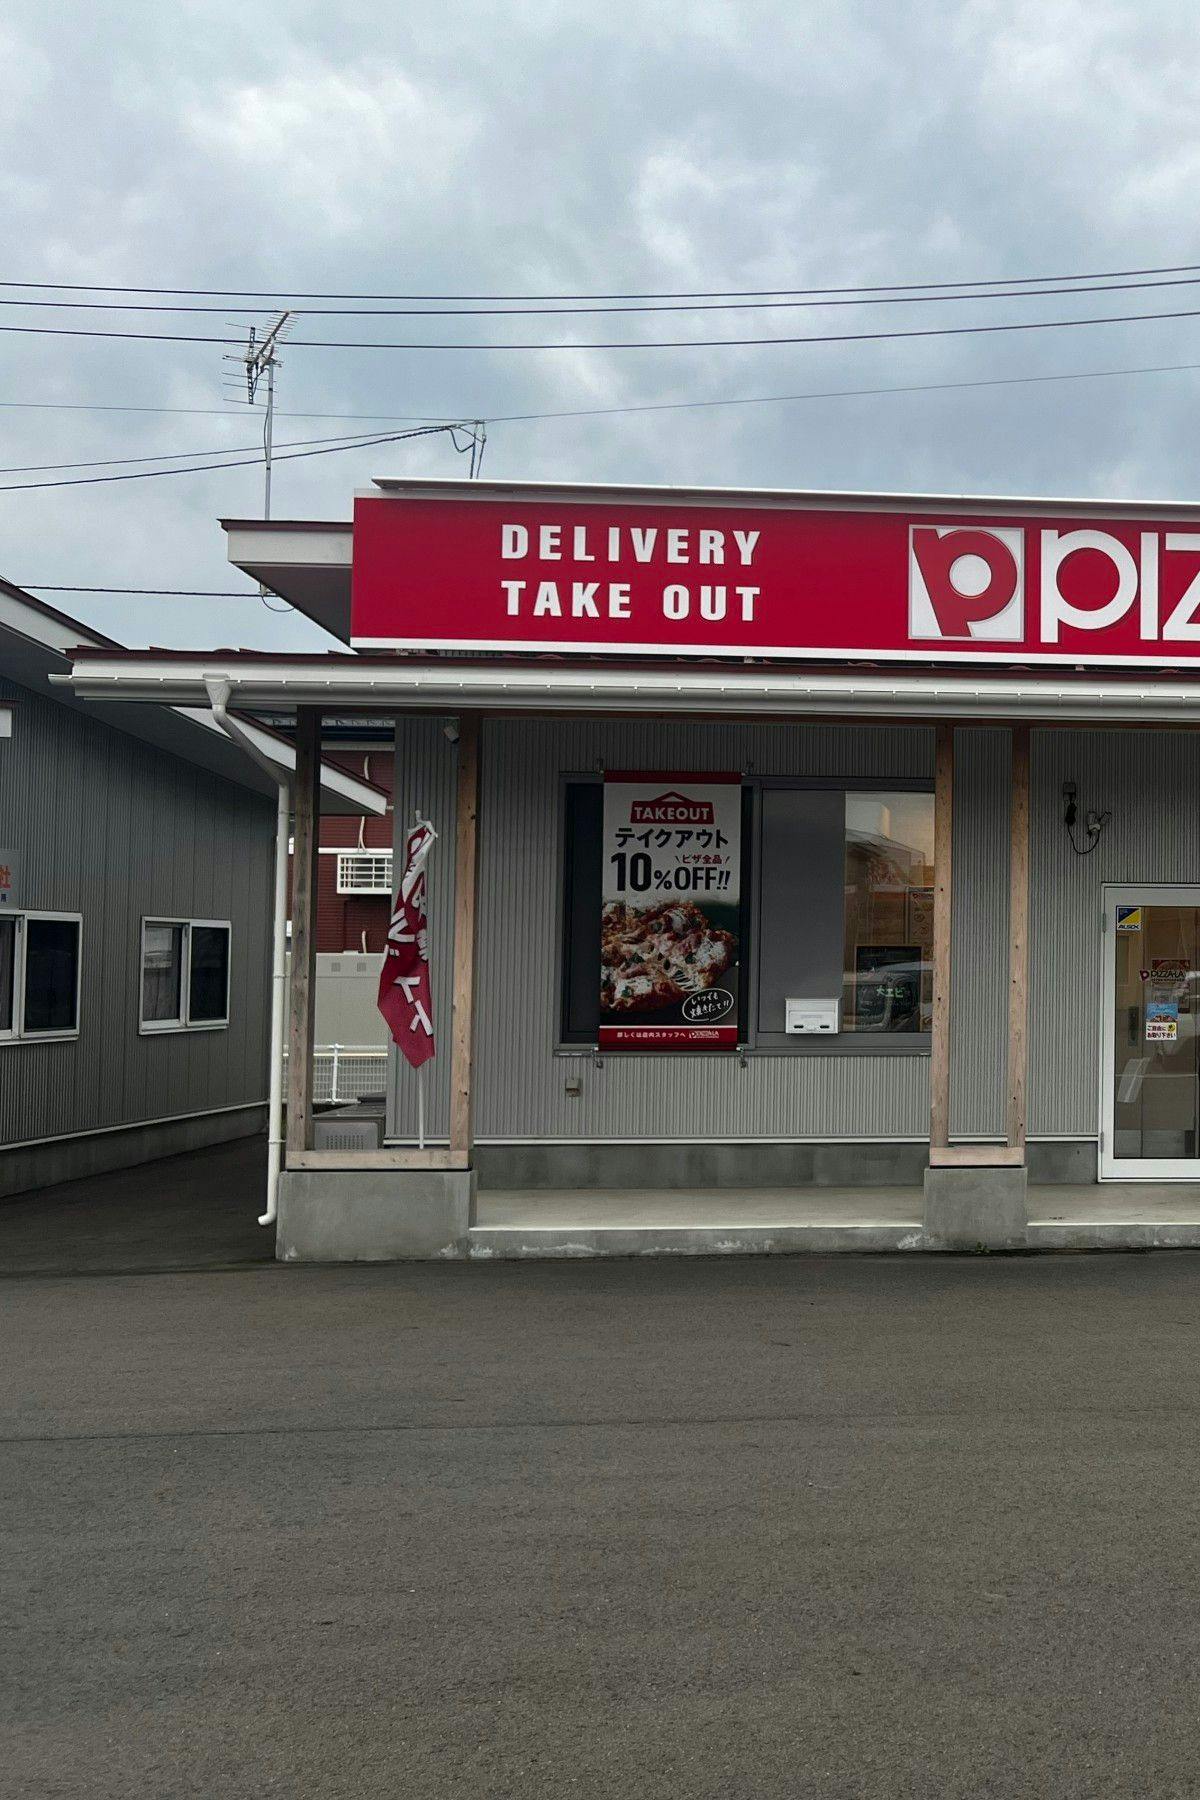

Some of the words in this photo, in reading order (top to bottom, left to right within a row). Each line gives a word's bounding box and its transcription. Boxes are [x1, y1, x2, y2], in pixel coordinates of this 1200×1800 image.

[502, 524, 761, 566] DELIVERY
[501, 580, 632, 620] TAKE
[663, 583, 761, 622] OUT
[633, 806, 710, 821] TAKEOUT
[615, 827, 729, 849] テイクアウト
[682, 854, 723, 865] ピザ全品
